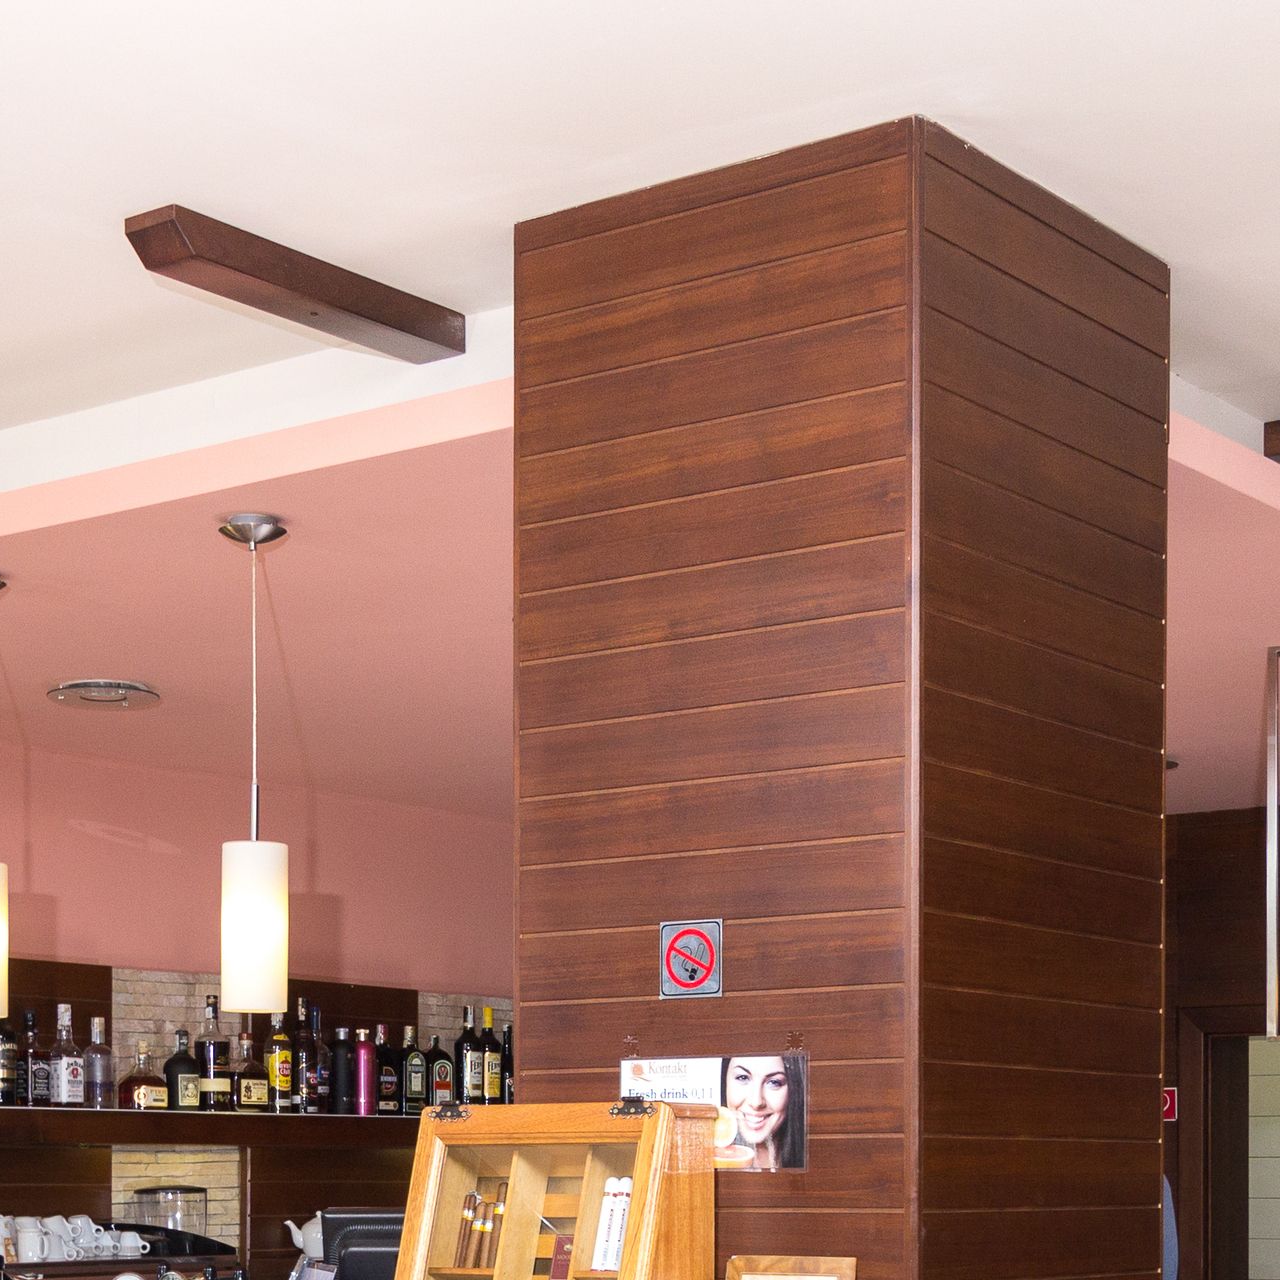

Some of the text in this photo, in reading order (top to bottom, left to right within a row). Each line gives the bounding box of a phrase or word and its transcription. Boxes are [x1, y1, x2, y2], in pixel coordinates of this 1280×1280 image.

[648, 1061, 688, 1074] Kontakt
[628, 1088, 657, 1099] Fresh
[660, 1088, 689, 1099] drink
